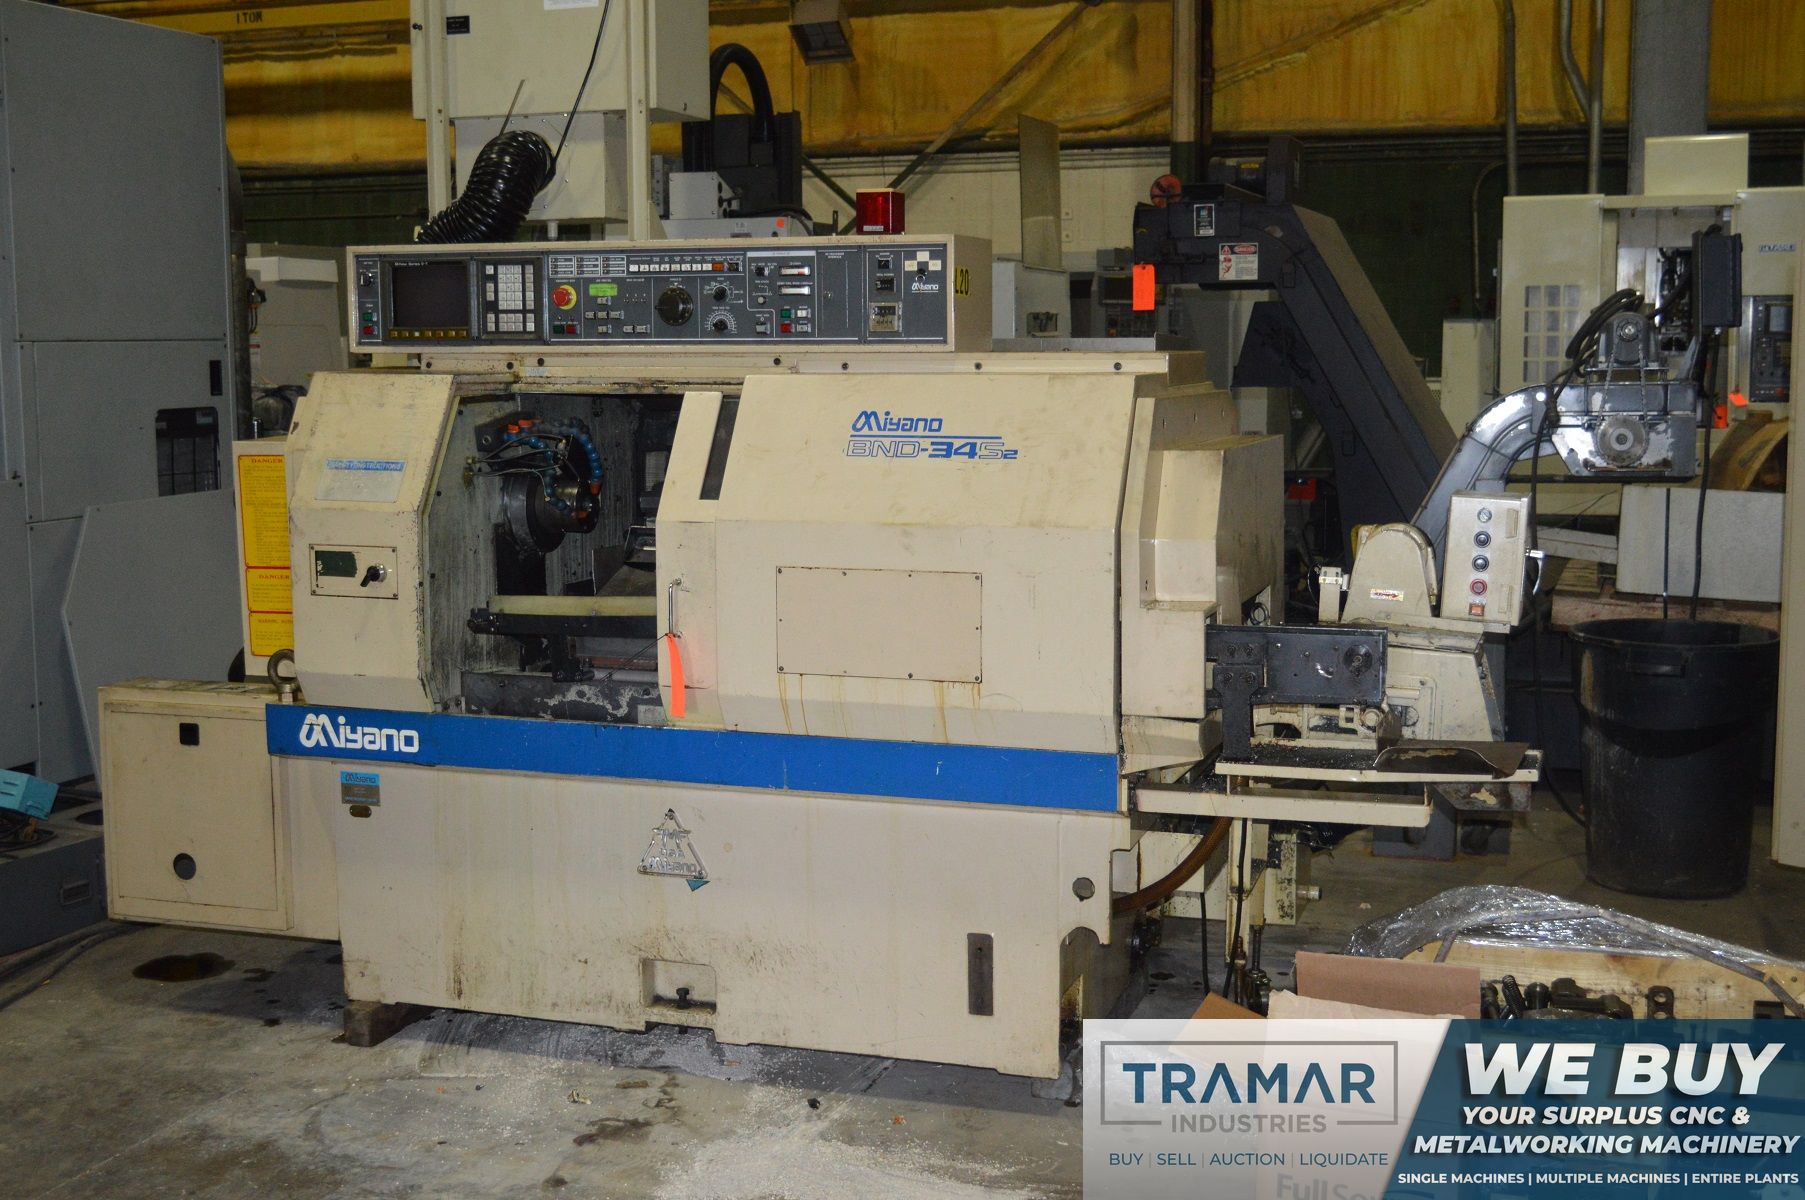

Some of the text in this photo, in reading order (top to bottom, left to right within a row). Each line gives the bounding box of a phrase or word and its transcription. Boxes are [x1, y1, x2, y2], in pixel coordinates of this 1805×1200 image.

[242, 11, 263, 24] TON
[851, 410, 943, 433] Miyano
[299, 713, 420, 753] Miyano
